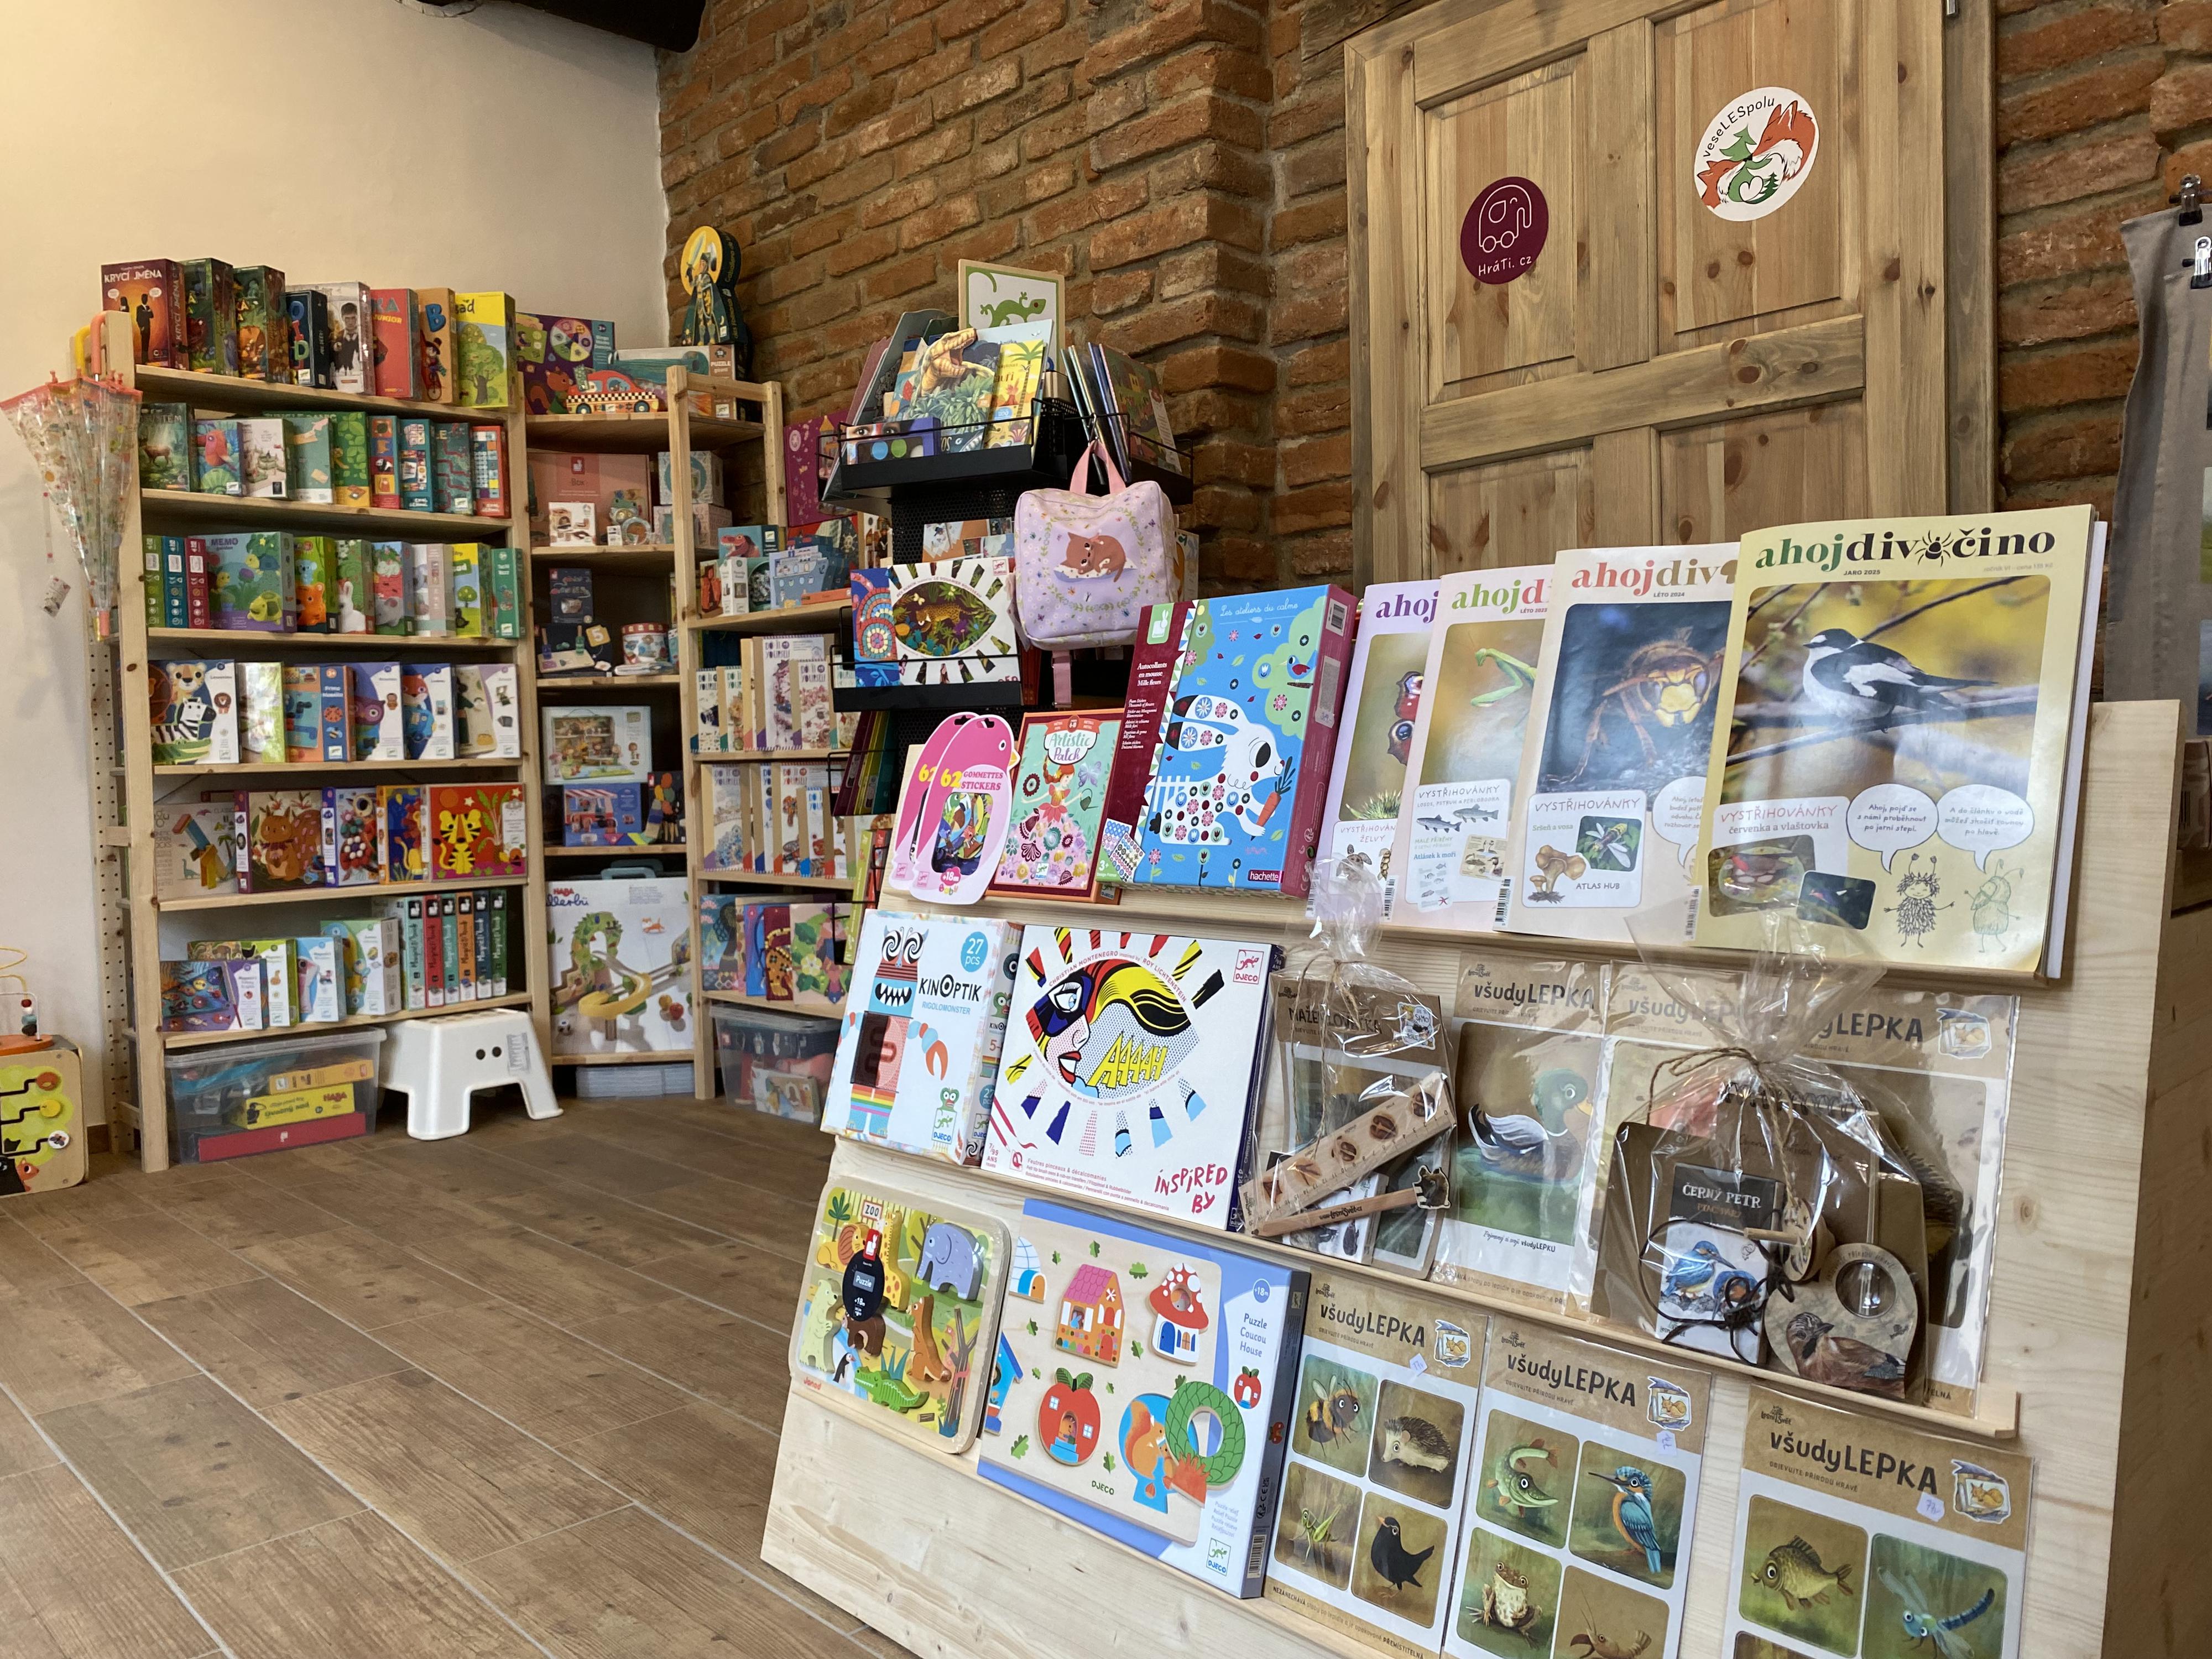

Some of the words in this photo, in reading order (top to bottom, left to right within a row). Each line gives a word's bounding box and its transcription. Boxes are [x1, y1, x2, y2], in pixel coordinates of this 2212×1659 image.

[1703, 96, 1776, 158] veseLESpolu
[103, 271, 130, 284] KRYCÍ
[133, 268, 163, 281] JMÉNA
[211, 537, 239, 546] MEMO
[1276, 597, 1298, 611] calme
[1048, 732, 1091, 748] Artistic
[1053, 747, 1081, 761] Patch
[940, 768, 963, 787] 62
[963, 771, 1004, 779] GOMMETTES
[961, 781, 1001, 791] STICKERS
[1418, 785, 1500, 799] VYSTŘIHOVÁNKY
[1535, 797, 1641, 812] VYSTŘIHOVÁNKY
[1721, 804, 1838, 823] VYSTŘIHOVÁNKY
[1729, 824, 1771, 834] červenka
[1781, 821, 1829, 831] vlaštovka
[1359, 834, 1385, 843] ŽELVY
[1249, 870, 1280, 881] hachette
[553, 888, 575, 896] HABA
[967, 938, 984, 954] 27
[964, 955, 981, 967] pcs
[1048, 963, 1077, 987] CHRISTIAN
[1078, 951, 1119, 966] MONTENEGRO
[1142, 958, 1154, 968] ROY
[1154, 966, 1187, 1002] LICHTENSTEIN
[1235, 973, 1259, 983] DJECO
[919, 974, 983, 1002] KINOPTIK
[1474, 982, 1595, 1009] všudyLEPKA
[922, 1001, 971, 1015] RIGOLOMONSTER
[323, 1092, 348, 1102] HABA
[932, 1131, 952, 1142] DJECO
[1027, 1158, 1044, 1167] Feutres
[1045, 1162, 1066, 1172] pinceaux
[1072, 1168, 1107, 1182] décalcomanies
[1191, 1191, 1215, 1214] BY
[1682, 1182, 1723, 1201] ČERNÝ
[1725, 1192, 1762, 1209] PETR
[865, 1204, 880, 1217] ZOO
[855, 1275, 873, 1288] Puzzle
[1244, 1313, 1267, 1330] Puzzle
[1320, 1302, 1425, 1348] všudyLEPKA
[1240, 1327, 1266, 1344] Coucou
[1240, 1341, 1262, 1358] House
[1359, 1339, 1374, 1349] HRAVĚ
[804, 1376, 822, 1390] Janod
[1507, 1353, 1636, 1407] všudyLEPKA
[1505, 1379, 1532, 1393] OBJEVUJTE
[1532, 1387, 1556, 1401] PŘÍRODU
[1557, 1395, 1574, 1406] HRAVĚ
[1770, 1431, 1938, 1495] všudyLEPKA
[1769, 1460, 1804, 1477] OBJEVUJTE
[1804, 1470, 1834, 1486] PŘÍRODU
[1835, 1479, 1859, 1493] HRAVĚ
[1091, 1479, 1115, 1495] DJECO
[1208, 1559, 1227, 1573] DJECO
[1272, 1585, 1306, 1606] NEZANECHÁVÁ
[1383, 1635, 1425, 1659] PŘEMÍSTITELNÁ
